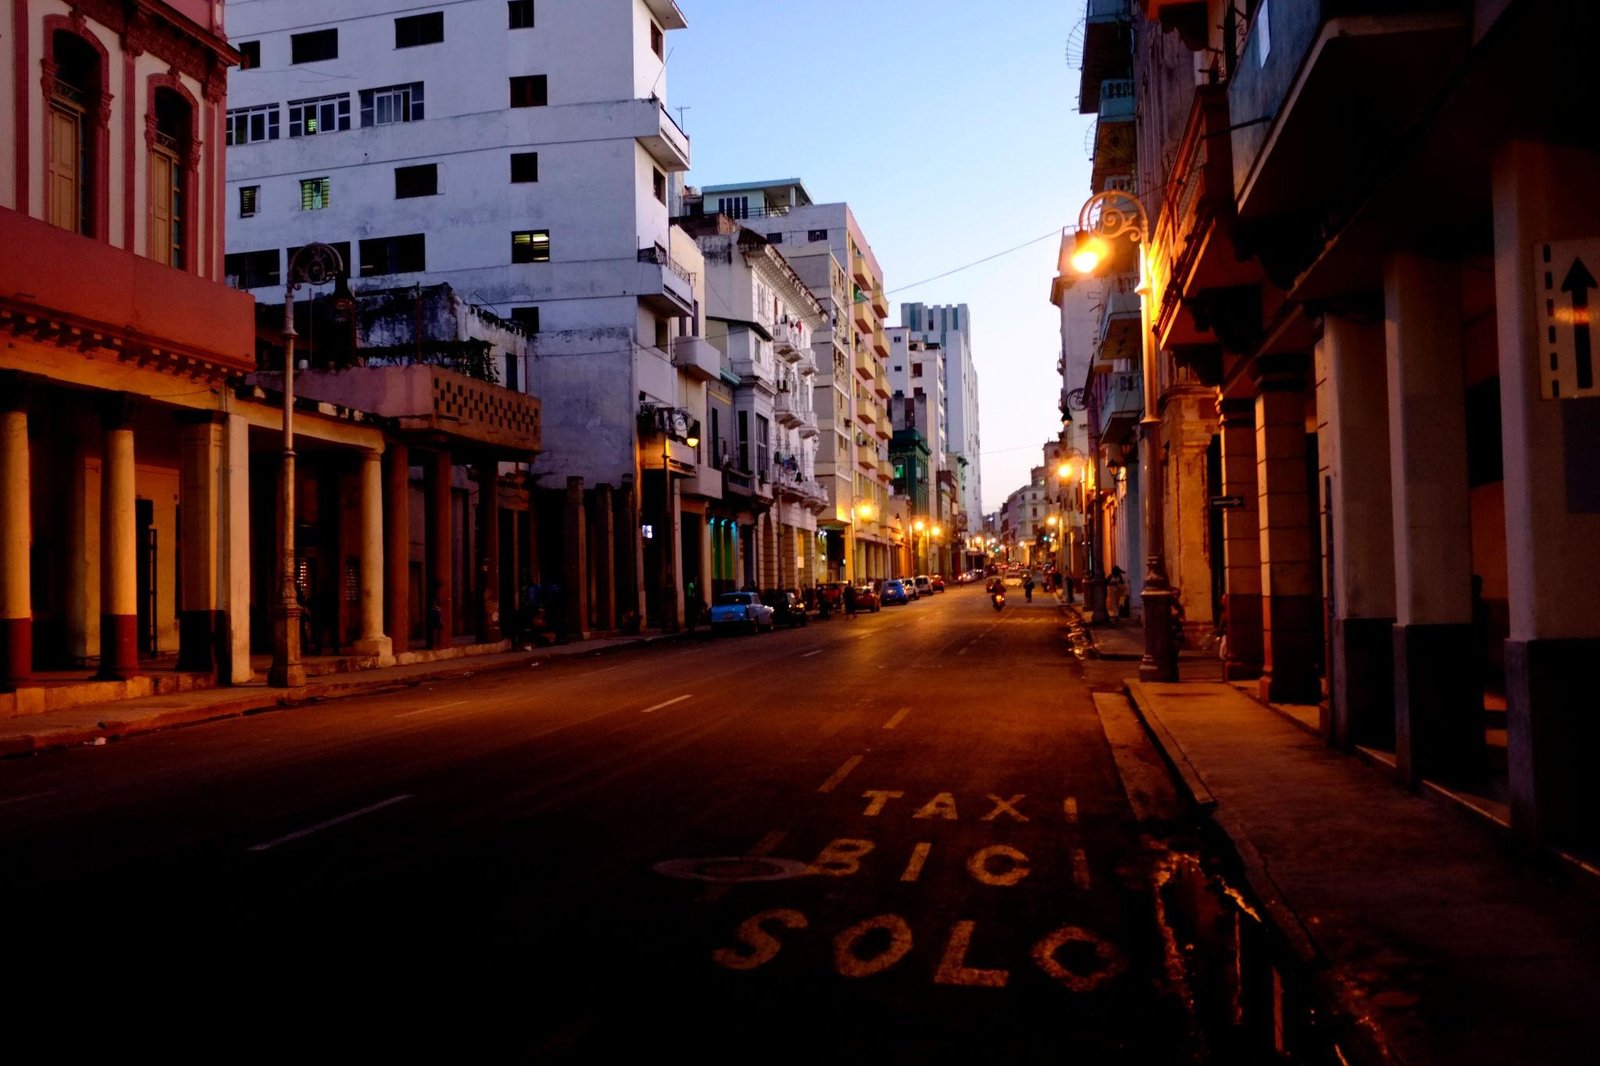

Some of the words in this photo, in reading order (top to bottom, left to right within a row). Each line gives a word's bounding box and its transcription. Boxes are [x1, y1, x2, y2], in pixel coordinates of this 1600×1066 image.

[861, 789, 1078, 823] TAXI
[806, 838, 1091, 890] BICI
[711, 907, 1132, 993] SOLO
